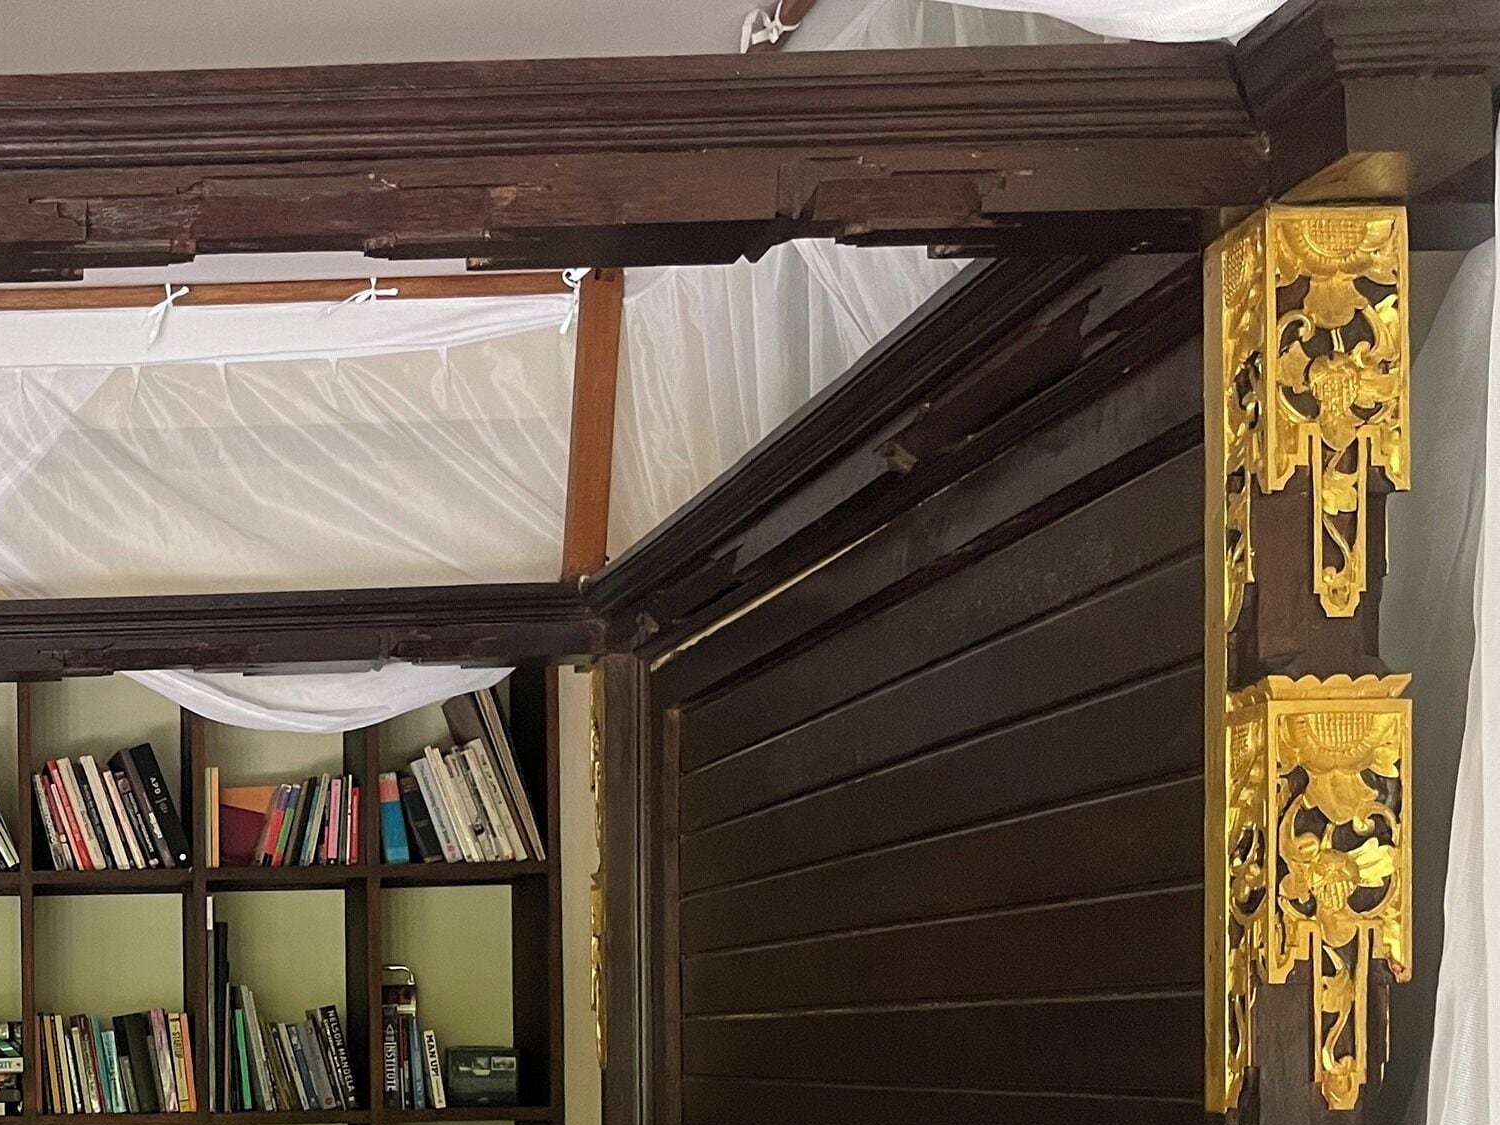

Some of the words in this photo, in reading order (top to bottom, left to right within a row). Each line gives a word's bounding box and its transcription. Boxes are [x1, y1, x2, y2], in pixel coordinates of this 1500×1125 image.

[327, 1010, 343, 1047] NELSON
[338, 1048, 356, 1092] MANDELA
[384, 1042, 398, 1092] INSTITUTE
[426, 1034, 437, 1058] MAN
